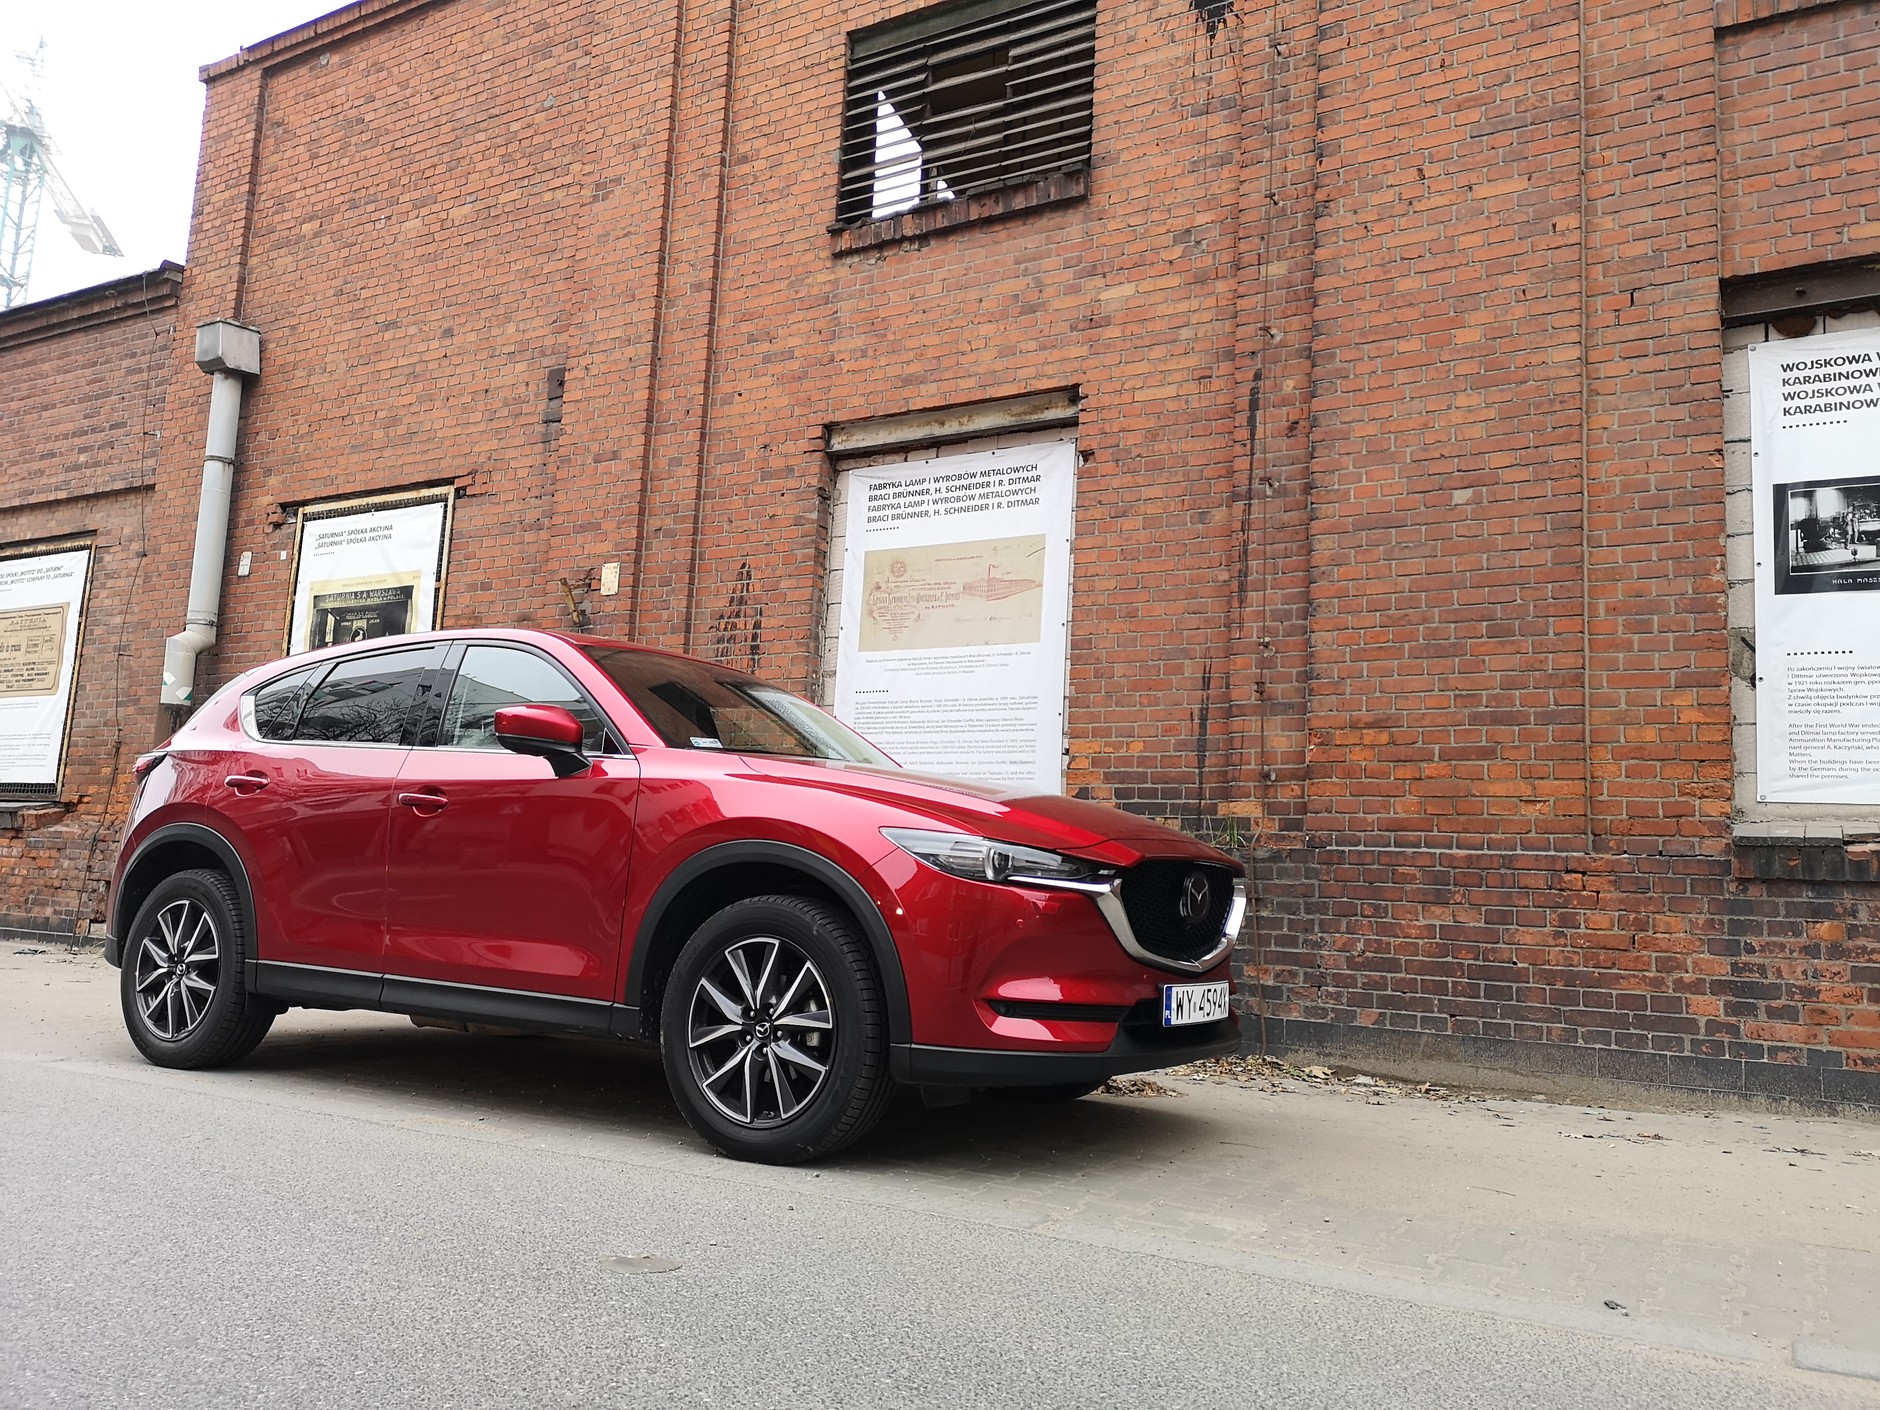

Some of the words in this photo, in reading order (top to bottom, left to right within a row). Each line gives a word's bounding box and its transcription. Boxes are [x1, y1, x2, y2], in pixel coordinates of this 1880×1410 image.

[1780, 353, 1872, 372] WOJSKOWA
[1782, 384, 1873, 401] WOJSKOWA
[869, 481, 902, 491] FABRYKA
[905, 478, 926, 487] LAMP
[933, 470, 977, 483] WYROBÓW
[979, 464, 1037, 478] METALOWYCH
[869, 493, 890, 502] BRACI
[945, 481, 991, 493] SCHNEIDER
[1008, 475, 1041, 485] DITMAR
[867, 515, 889, 523] BRACI
[944, 503, 989, 515] SCHNEIDER
[1007, 498, 1039, 508] DITMAR
[868, 503, 901, 513] FABRYKA
[904, 500, 925, 508] LAMP
[932, 492, 976, 505] WYROBÓW
[978, 487, 1036, 500] METALOWYCH
[368, 534, 392, 542] AKCYJNA
[326, 592, 354, 601] SATURNIA
[369, 588, 400, 597] WARSZAWA
[1176, 990, 1194, 1020] WY
